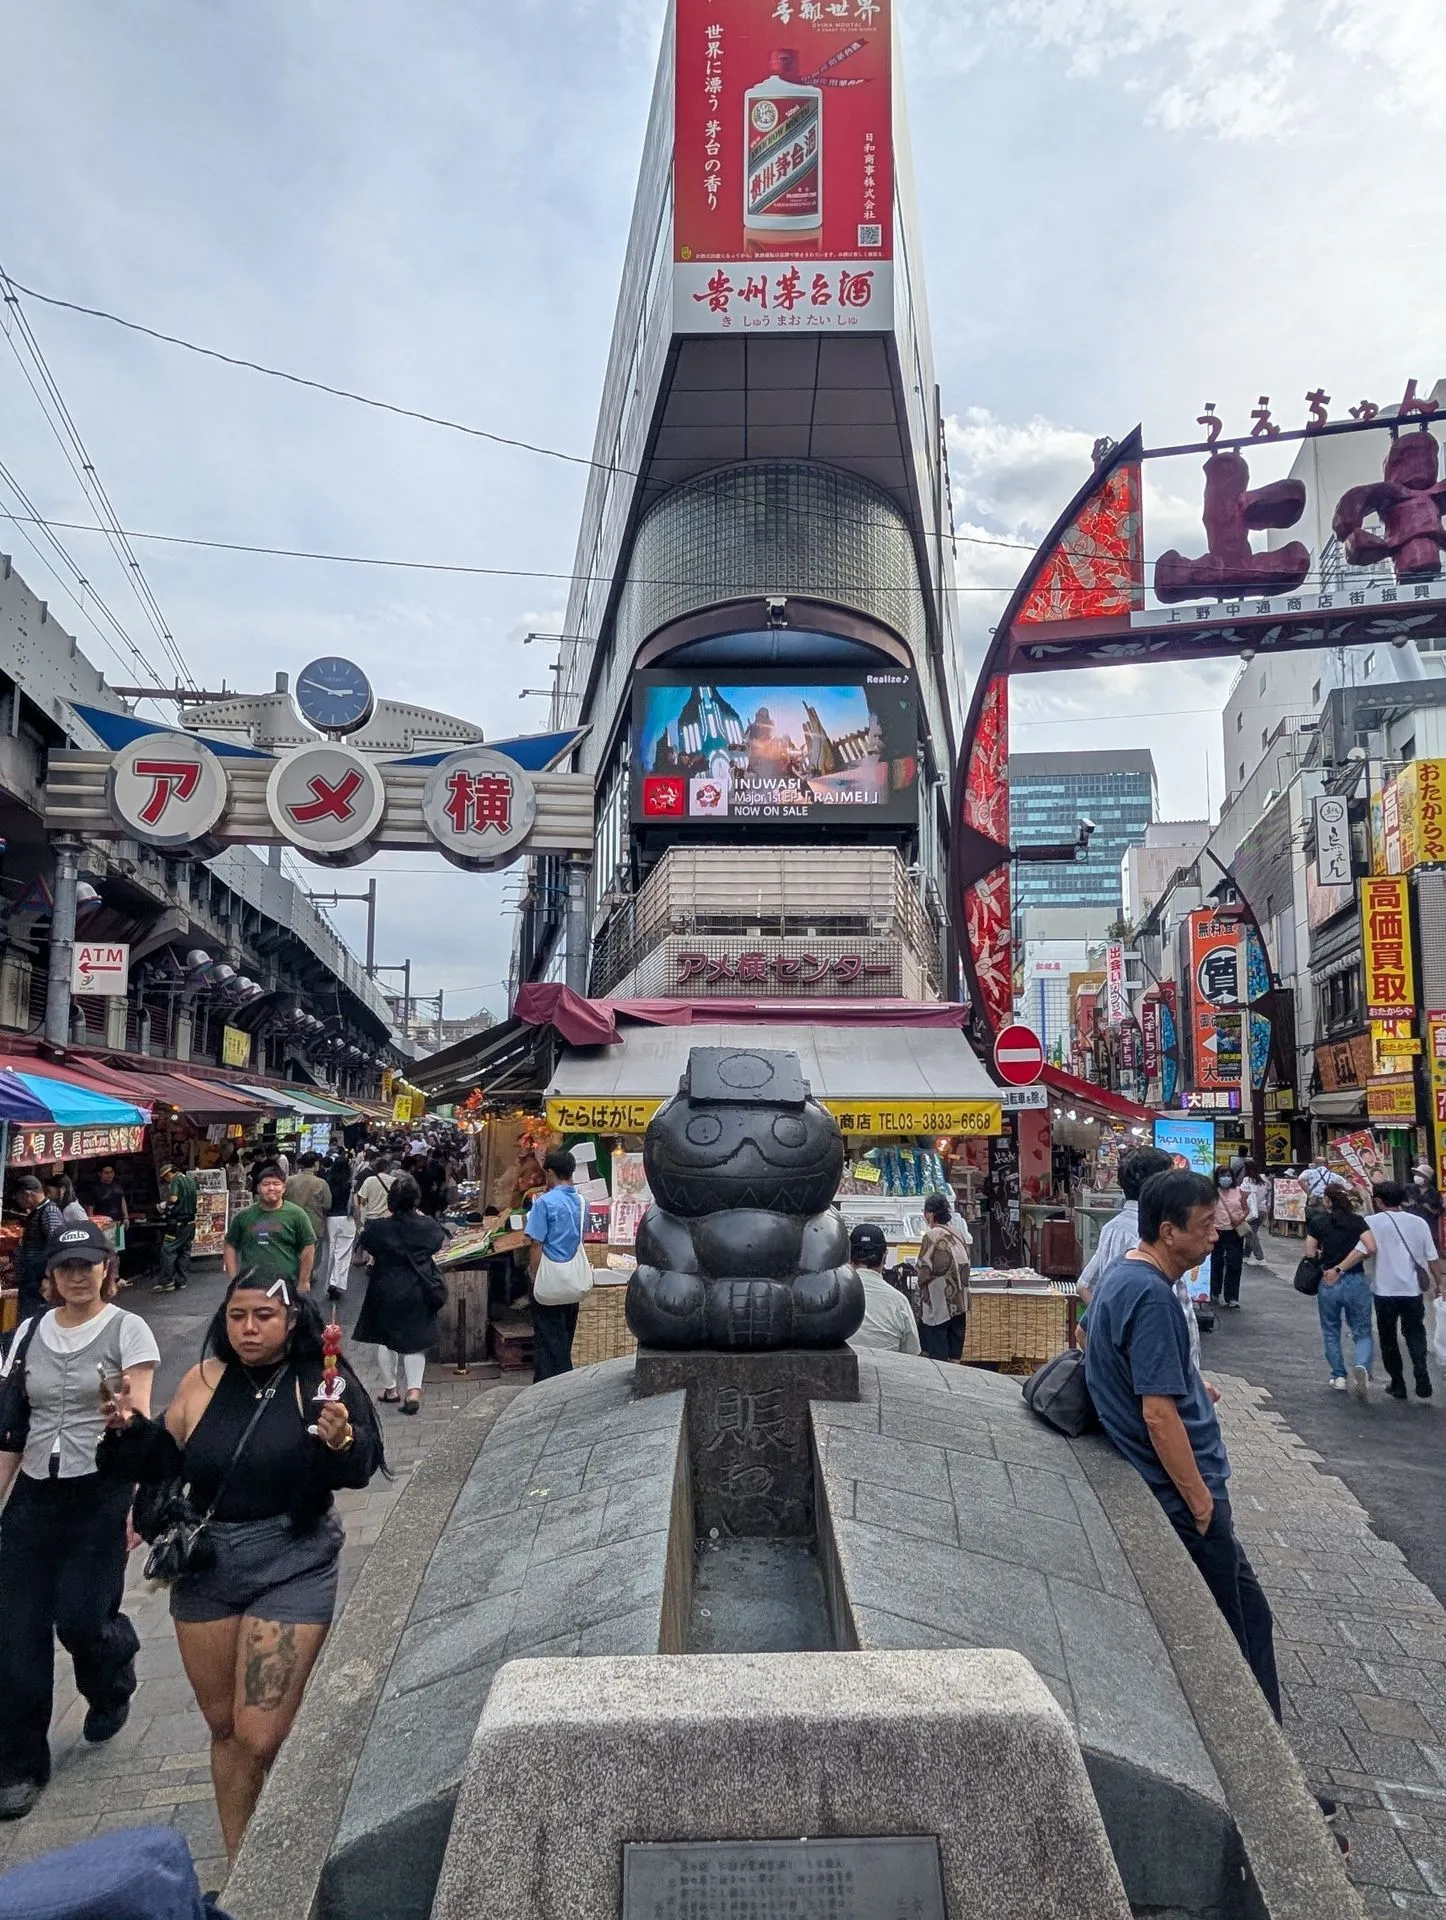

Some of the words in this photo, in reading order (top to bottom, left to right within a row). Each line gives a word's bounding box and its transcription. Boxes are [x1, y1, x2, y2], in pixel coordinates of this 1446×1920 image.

[704, 24, 724, 112] 世界に漂う
[703, 119, 722, 211] 茅台の香り
[863, 132, 876, 221] 日和商事株式会社
[692, 265, 875, 314] 貴州茅台酒
[1166, 585, 1431, 623] 上野中通商店街振興
[734, 778, 801, 790] INUWASI
[134, 758, 513, 836] アメ横
[734, 791, 765, 805] Major
[768, 791, 781, 802] 1st
[734, 806, 760, 816] NOW
[763, 806, 780, 816] ON
[782, 806, 808, 816] SALE
[1419, 763, 1446, 860] おたからや
[1197, 920, 1240, 938] 無料査
[1367, 879, 1408, 1002] 高価買取
[79, 948, 123, 962] ATM
[676, 952, 893, 984] アメ横センター
[1204, 955, 1239, 1002] 質
[1368, 1006, 1413, 1017] おたからや
[1381, 1042, 1420, 1051] おたからや
[1187, 1092, 1230, 1108] 大黒屋
[558, 1105, 645, 1127] たらばがに
[834, 1113, 871, 1130] 商店
[878, 1113, 991, 1130] TEL03-3833-6668
[1186, 1136, 1212, 1146] BOWL
